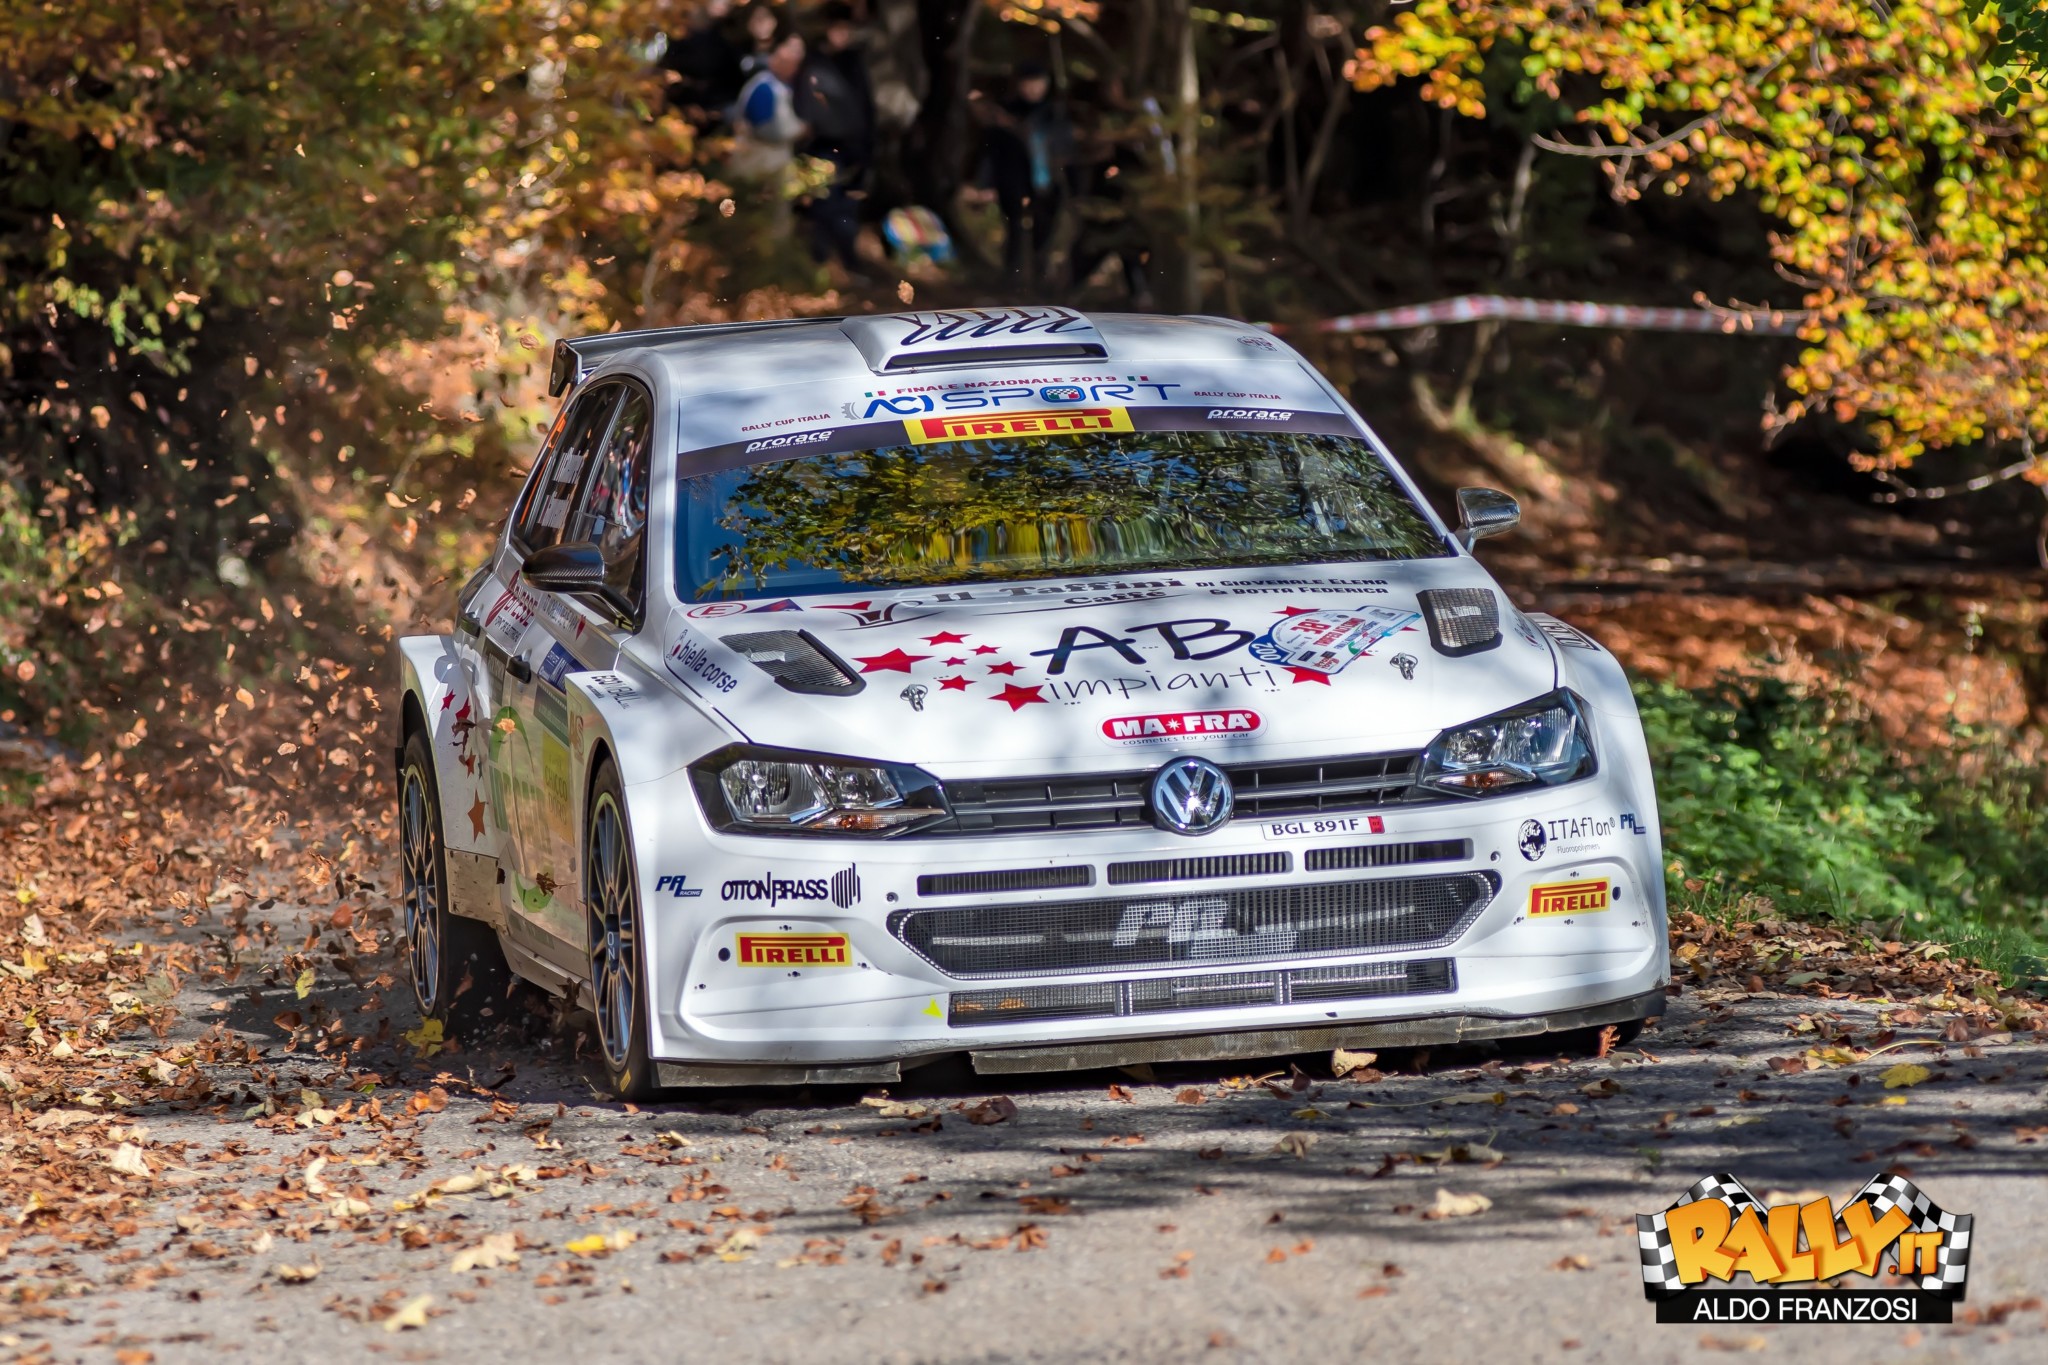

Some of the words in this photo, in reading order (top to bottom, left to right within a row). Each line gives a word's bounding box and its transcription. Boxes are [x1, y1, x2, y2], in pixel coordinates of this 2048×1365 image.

[896, 383, 960, 395] FINALE
[964, 377, 1064, 389] NAZIONALE
[940, 383, 1181, 410] SPORT
[741, 422, 772, 432] RALLY
[775, 418, 796, 427] CUP
[797, 413, 831, 423] ITALIA
[920, 408, 1114, 439] PIRELLI
[1209, 588, 1229, 596] &
[1298, 586, 1390, 594] FEDERICA
[1029, 618, 1256, 676] AB
[1251, 643, 1282, 662] 200
[677, 639, 708, 673] biella
[702, 663, 738, 693] corse
[1044, 664, 1276, 701] impianti
[1122, 736, 1179, 746] cosmetics
[1182, 734, 1198, 742] for
[1202, 733, 1228, 742] your
[1271, 821, 1311, 837] BGL
[1313, 818, 1360, 833] 891F
[1530, 881, 1608, 915] PIRELLI
[739, 936, 846, 963] PIRELLI
